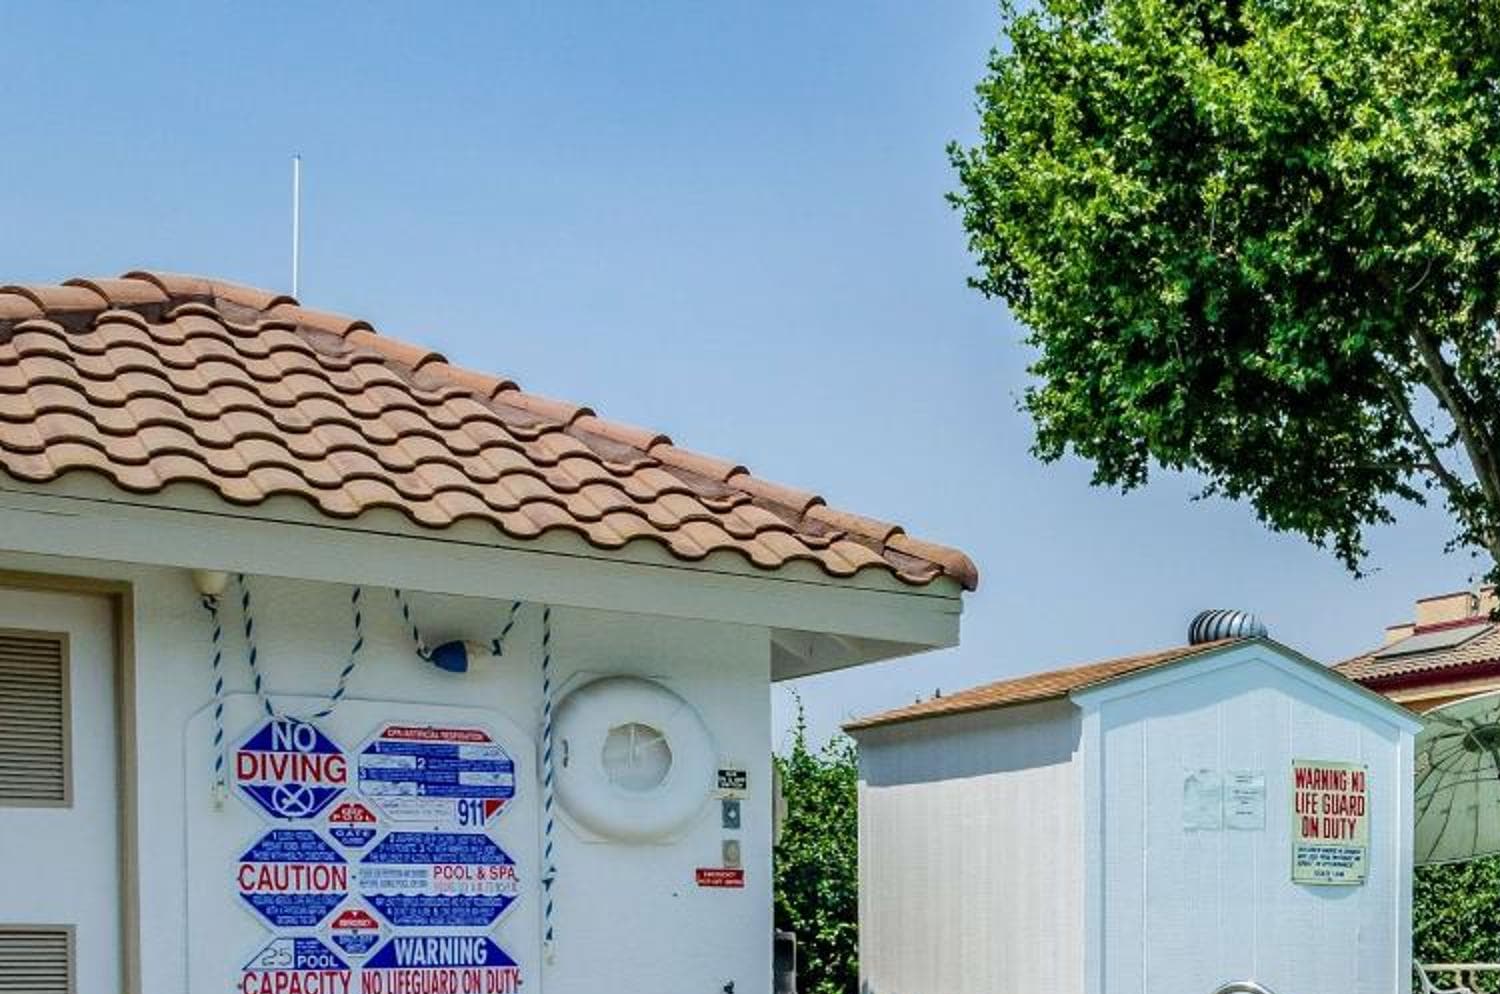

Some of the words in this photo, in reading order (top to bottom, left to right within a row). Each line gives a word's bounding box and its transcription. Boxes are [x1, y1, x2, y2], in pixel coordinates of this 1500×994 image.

[271, 721, 317, 752] NO
[237, 752, 347, 784] DIVING
[417, 758, 427, 770] 2
[1295, 768, 1347, 792] WARNING
[1351, 771, 1365, 793] NO
[458, 799, 485, 826] 911
[1295, 793, 1318, 815] LIFE
[1322, 796, 1365, 817] GUARD
[335, 829, 370, 837] GATE
[1301, 816, 1319, 839] ON
[1323, 818, 1357, 841] DUTY
[238, 864, 346, 891] CAUTION
[433, 866, 472, 881] POOL
[477, 867, 485, 880] &
[490, 866, 516, 880] SPA
[261, 947, 292, 966] 25
[297, 956, 339, 968] POOL
[393, 936, 487, 967] WARNING
[462, 969, 480, 994] ON
[487, 967, 519, 994] DUTY
